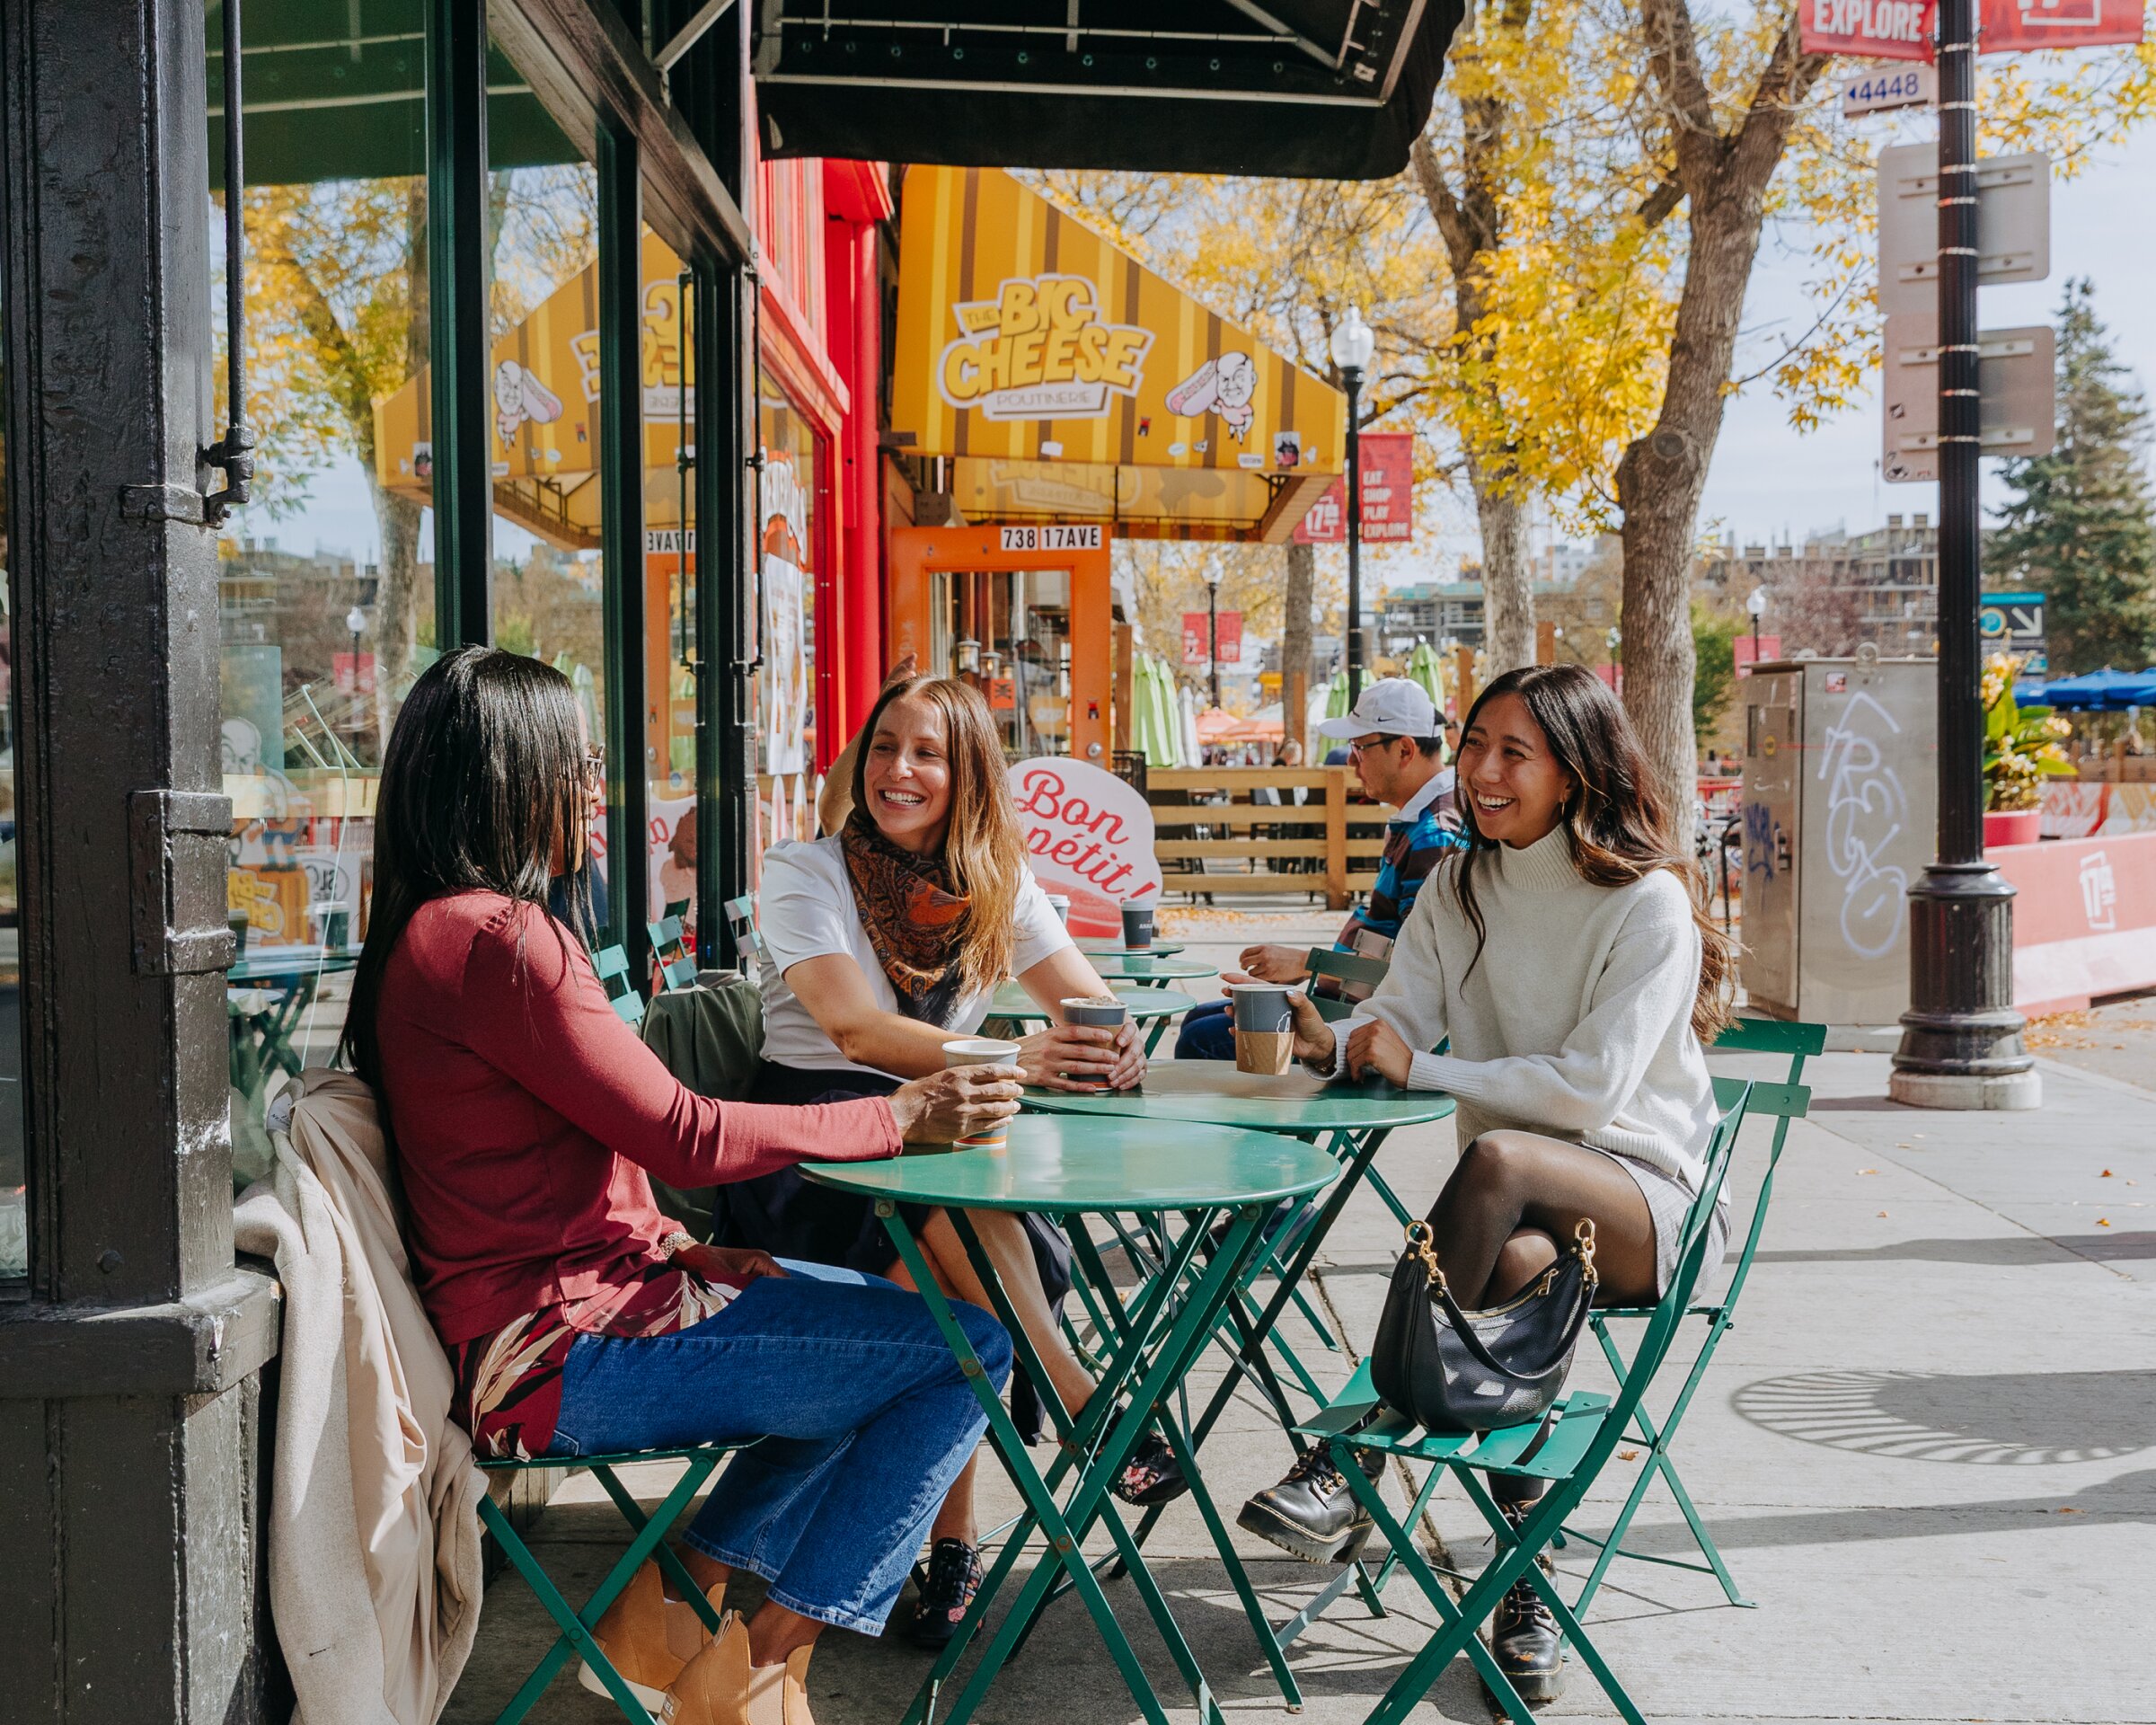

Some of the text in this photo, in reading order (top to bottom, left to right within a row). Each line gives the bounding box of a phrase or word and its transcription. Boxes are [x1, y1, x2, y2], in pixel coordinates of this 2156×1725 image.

[1813, 0, 1923, 41] EXPLORE
[1859, 73, 1919, 102] 4448
[966, 280, 1095, 338] THE BIG
[944, 325, 1147, 400] CHEESE
[996, 390, 1092, 407] POUTINERIE
[1003, 529, 1035, 548] 738
[1013, 769, 1129, 845] Bon
[1026, 826, 1157, 903] pétit!
